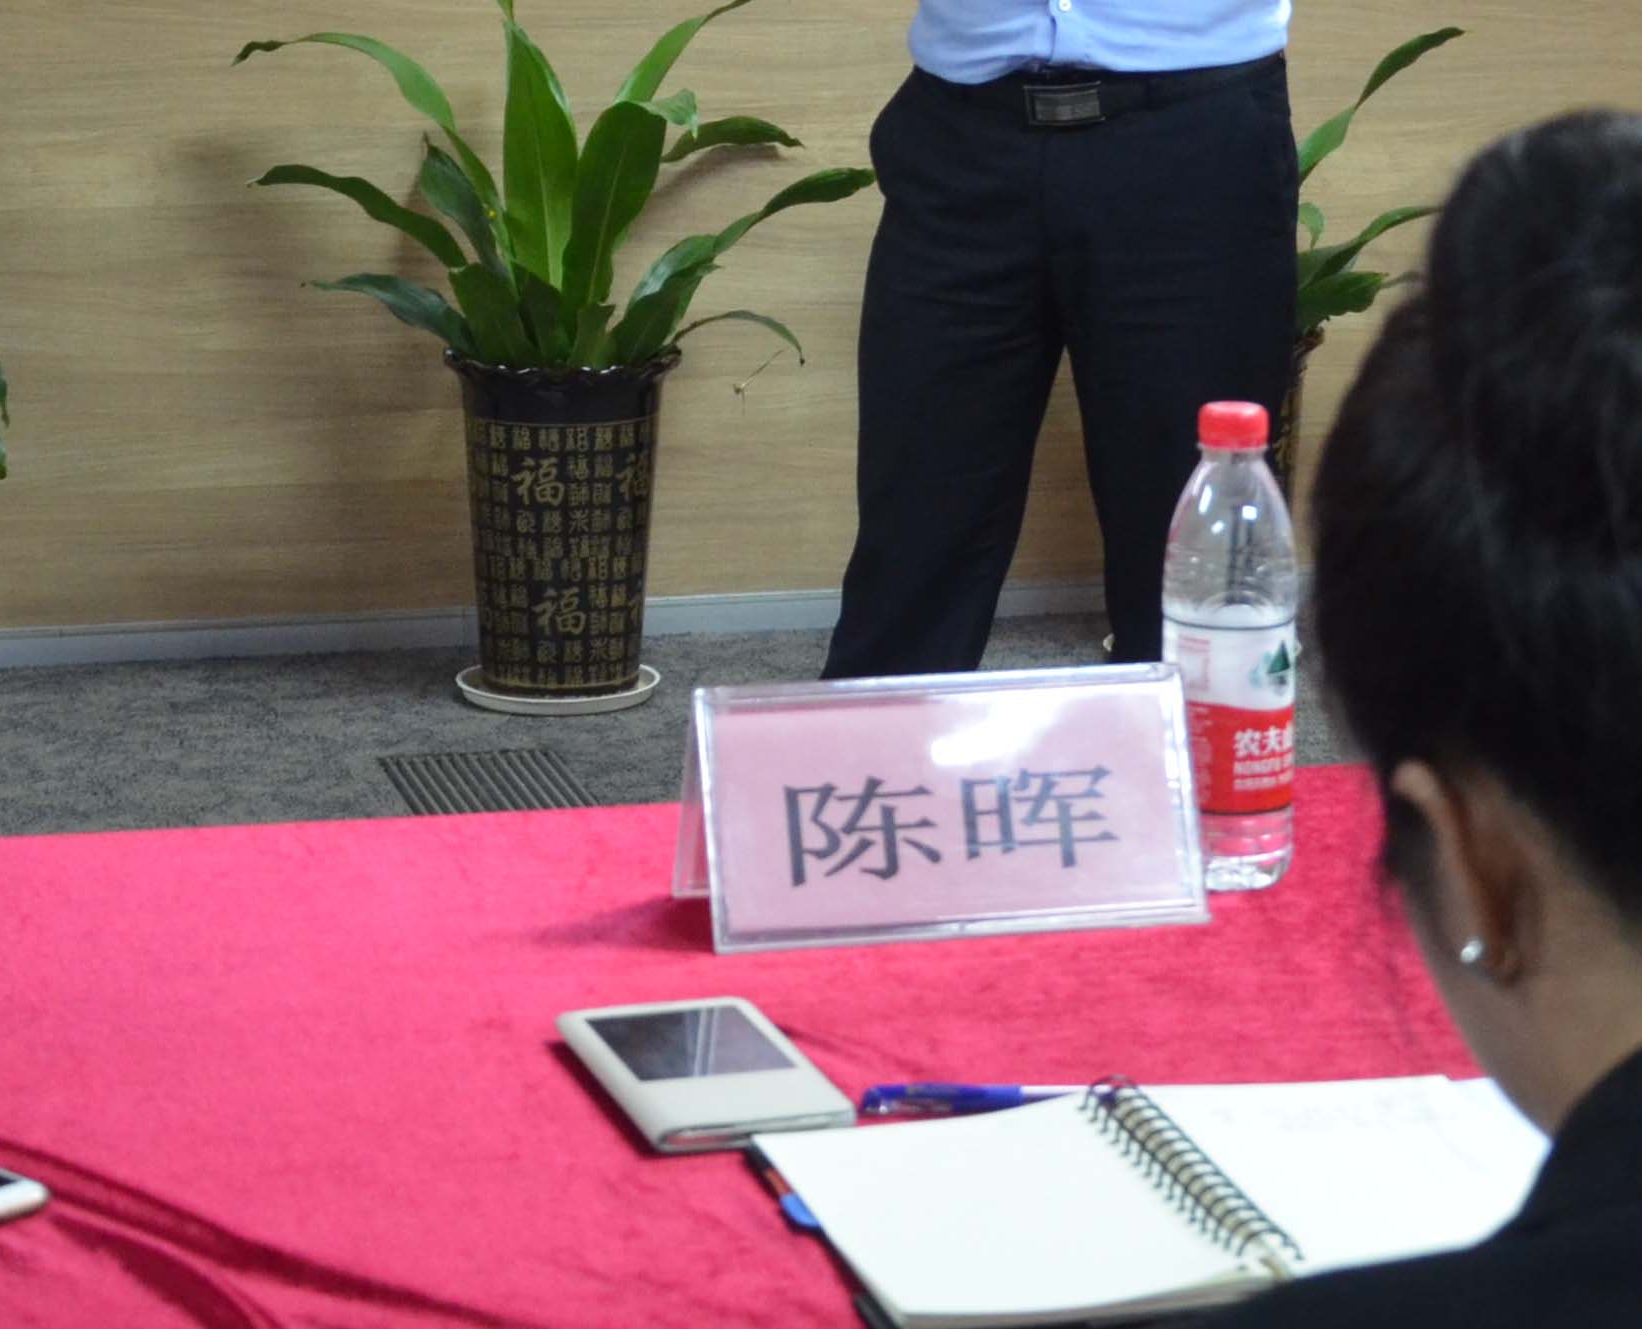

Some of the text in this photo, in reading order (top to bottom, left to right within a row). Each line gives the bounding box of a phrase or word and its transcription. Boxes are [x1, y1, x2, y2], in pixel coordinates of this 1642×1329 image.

[510, 456, 566, 507] 福
[530, 587, 587, 635] 福
[782, 764, 1120, 888] 陈晖
